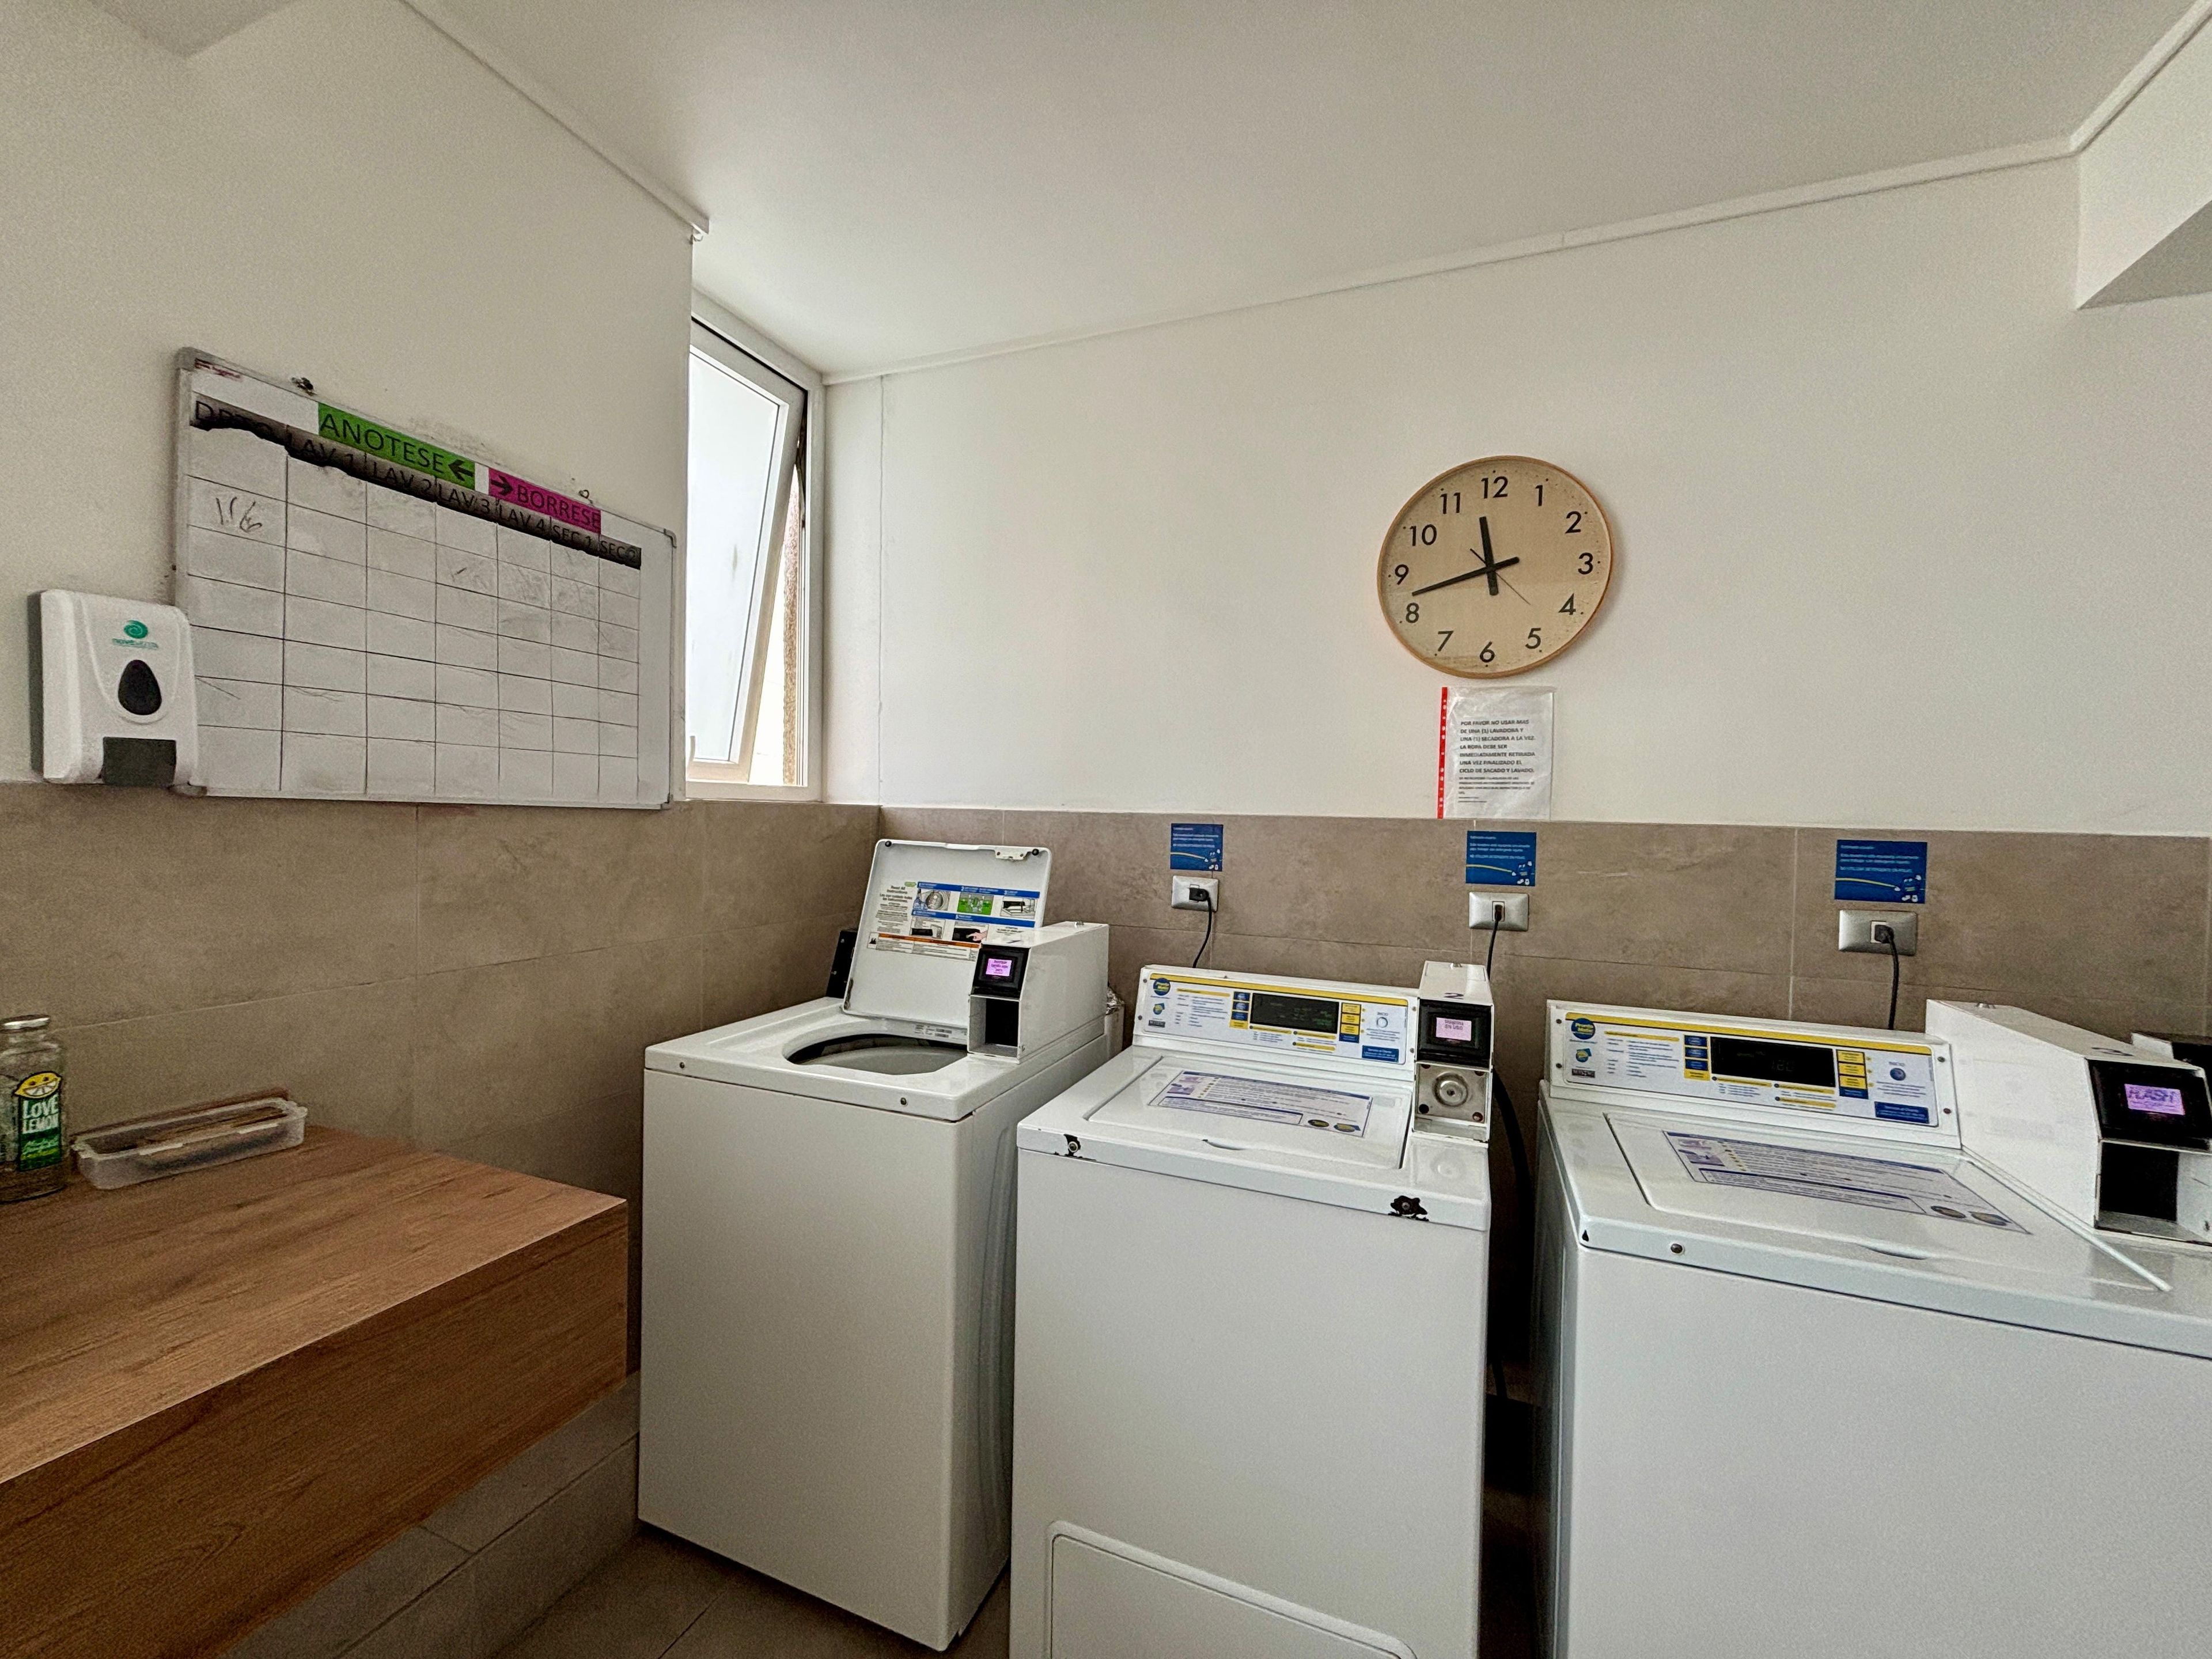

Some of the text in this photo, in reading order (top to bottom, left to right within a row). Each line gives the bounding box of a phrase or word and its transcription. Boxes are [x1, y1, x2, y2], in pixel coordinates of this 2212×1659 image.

[319, 414, 445, 474] ANOTESE
[374, 461, 432, 495] LAV 2
[1481, 476, 1508, 499] 12
[439, 484, 490, 514] LAV 3
[517, 484, 601, 529] BORRESE
[1440, 492, 1461, 514] 11
[1535, 485, 1543, 506] 1
[500, 505, 544, 532] LAV 4
[1565, 511, 1582, 533] 2
[552, 525, 579, 543] SEC
[1410, 524, 1437, 546] 10
[600, 540, 625, 559] SEC
[1578, 552, 1593, 574] 3
[1395, 564, 1409, 585] 9
[1406, 603, 1419, 623] 8
[1558, 593, 1576, 615] 4
[1438, 630, 1454, 652] 7
[1525, 628, 1541, 649] 5
[1480, 641, 1495, 662] 6
[23, 1093, 59, 1119] LOVE
